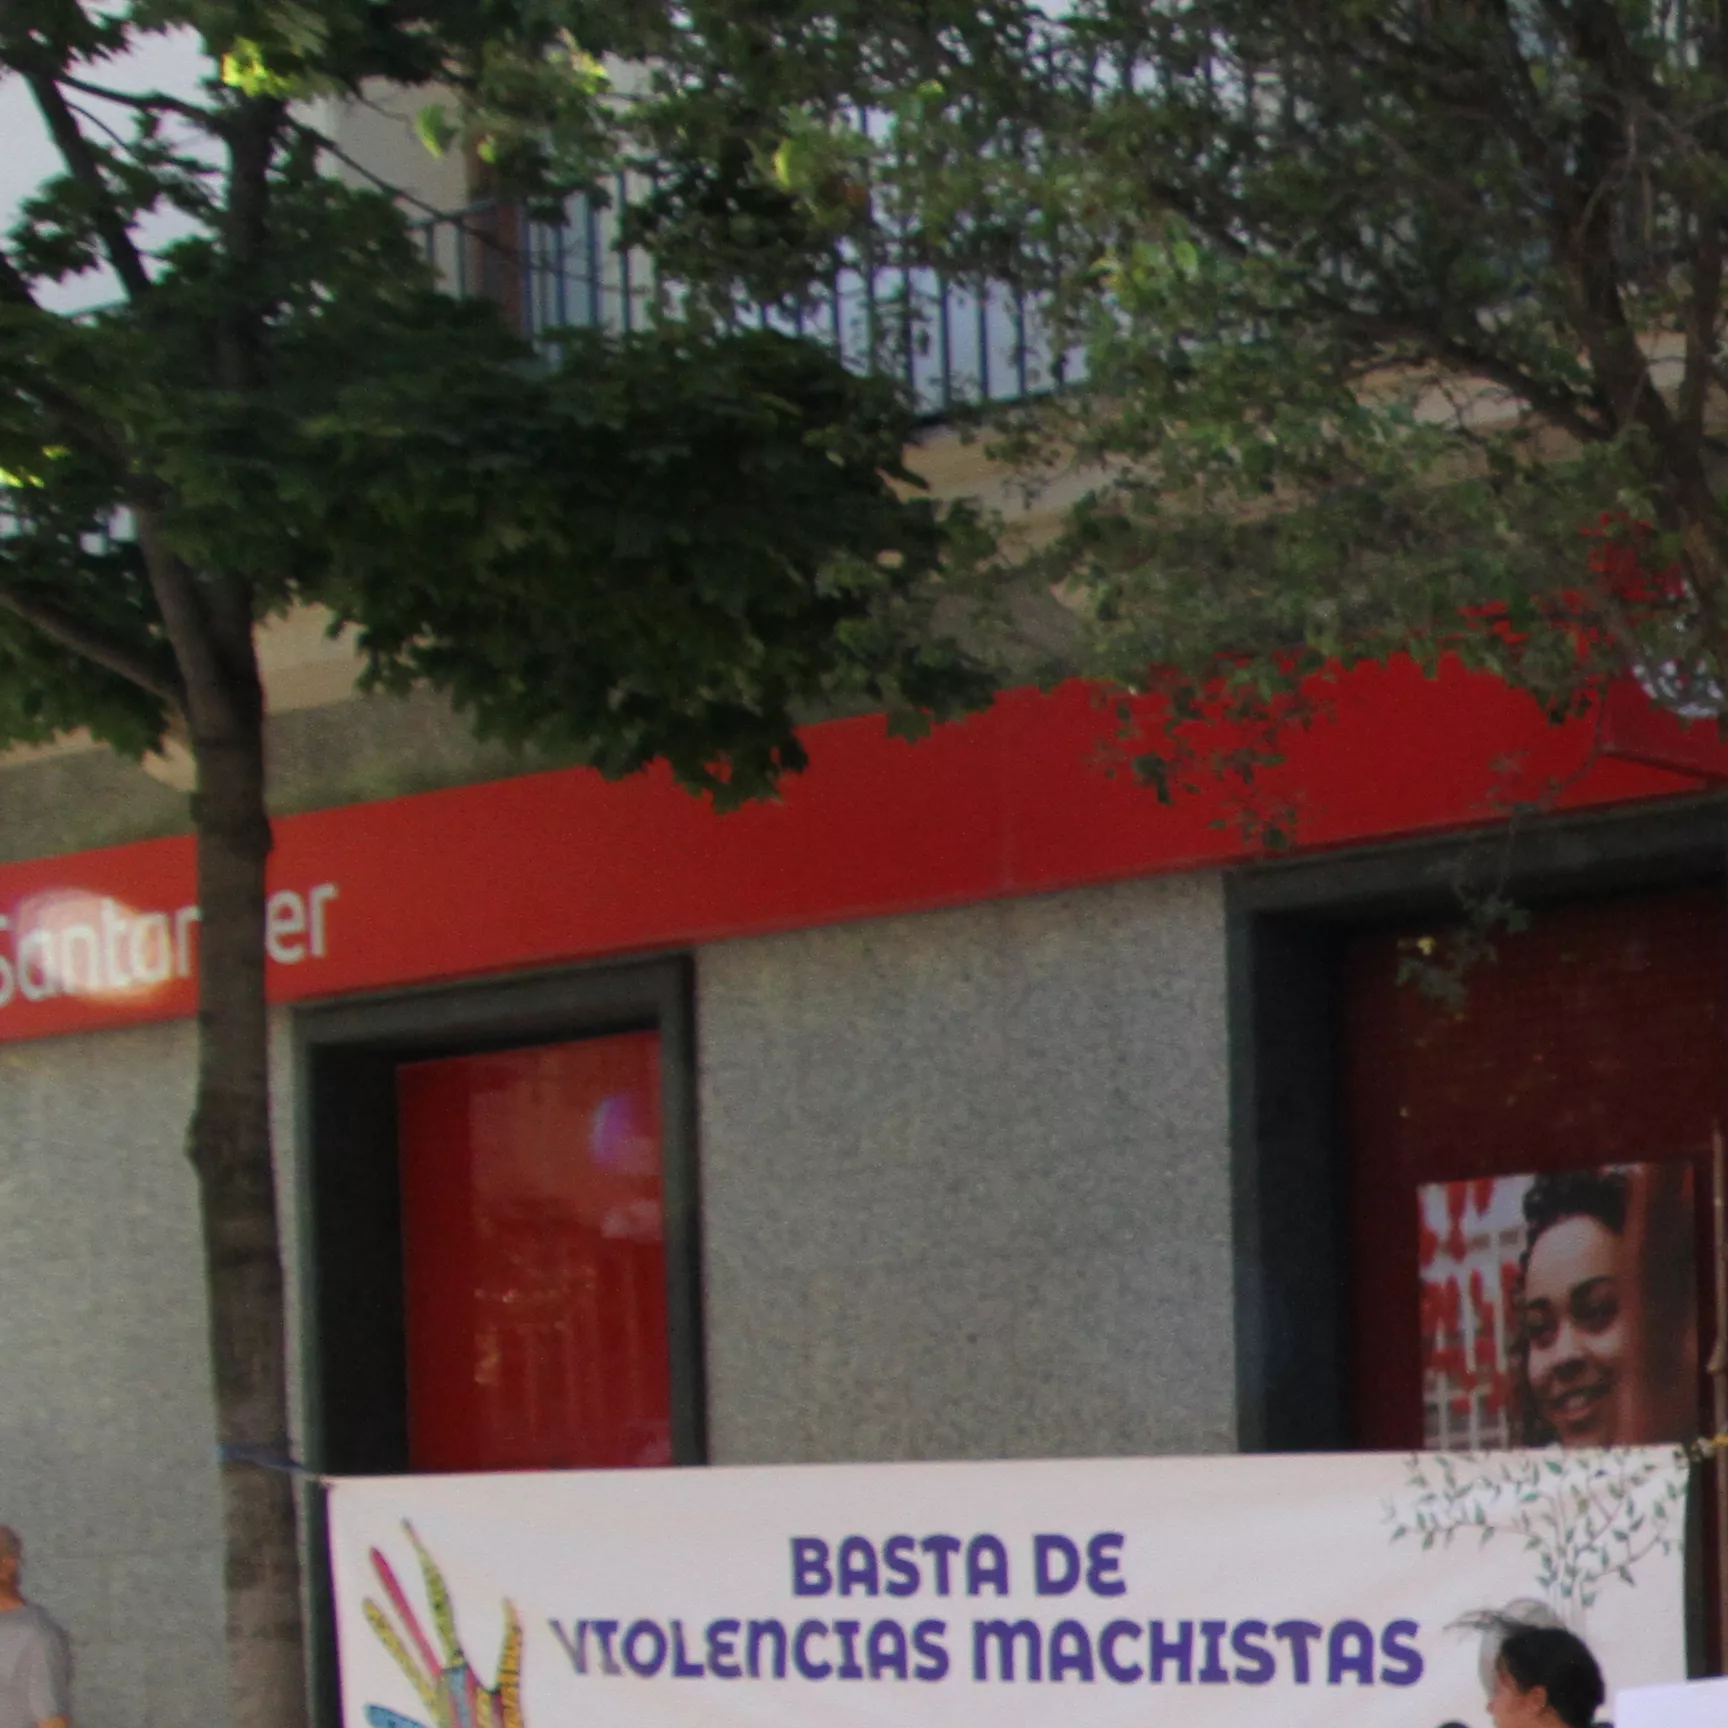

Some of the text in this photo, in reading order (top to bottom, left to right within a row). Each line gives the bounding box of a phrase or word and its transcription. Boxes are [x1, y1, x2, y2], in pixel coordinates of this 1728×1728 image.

[0, 883, 338, 1007] antaner
[790, 1531, 1127, 1598] BASTA DE
[549, 1618, 1424, 1687] VIOLENCIAS MACHISTAS
